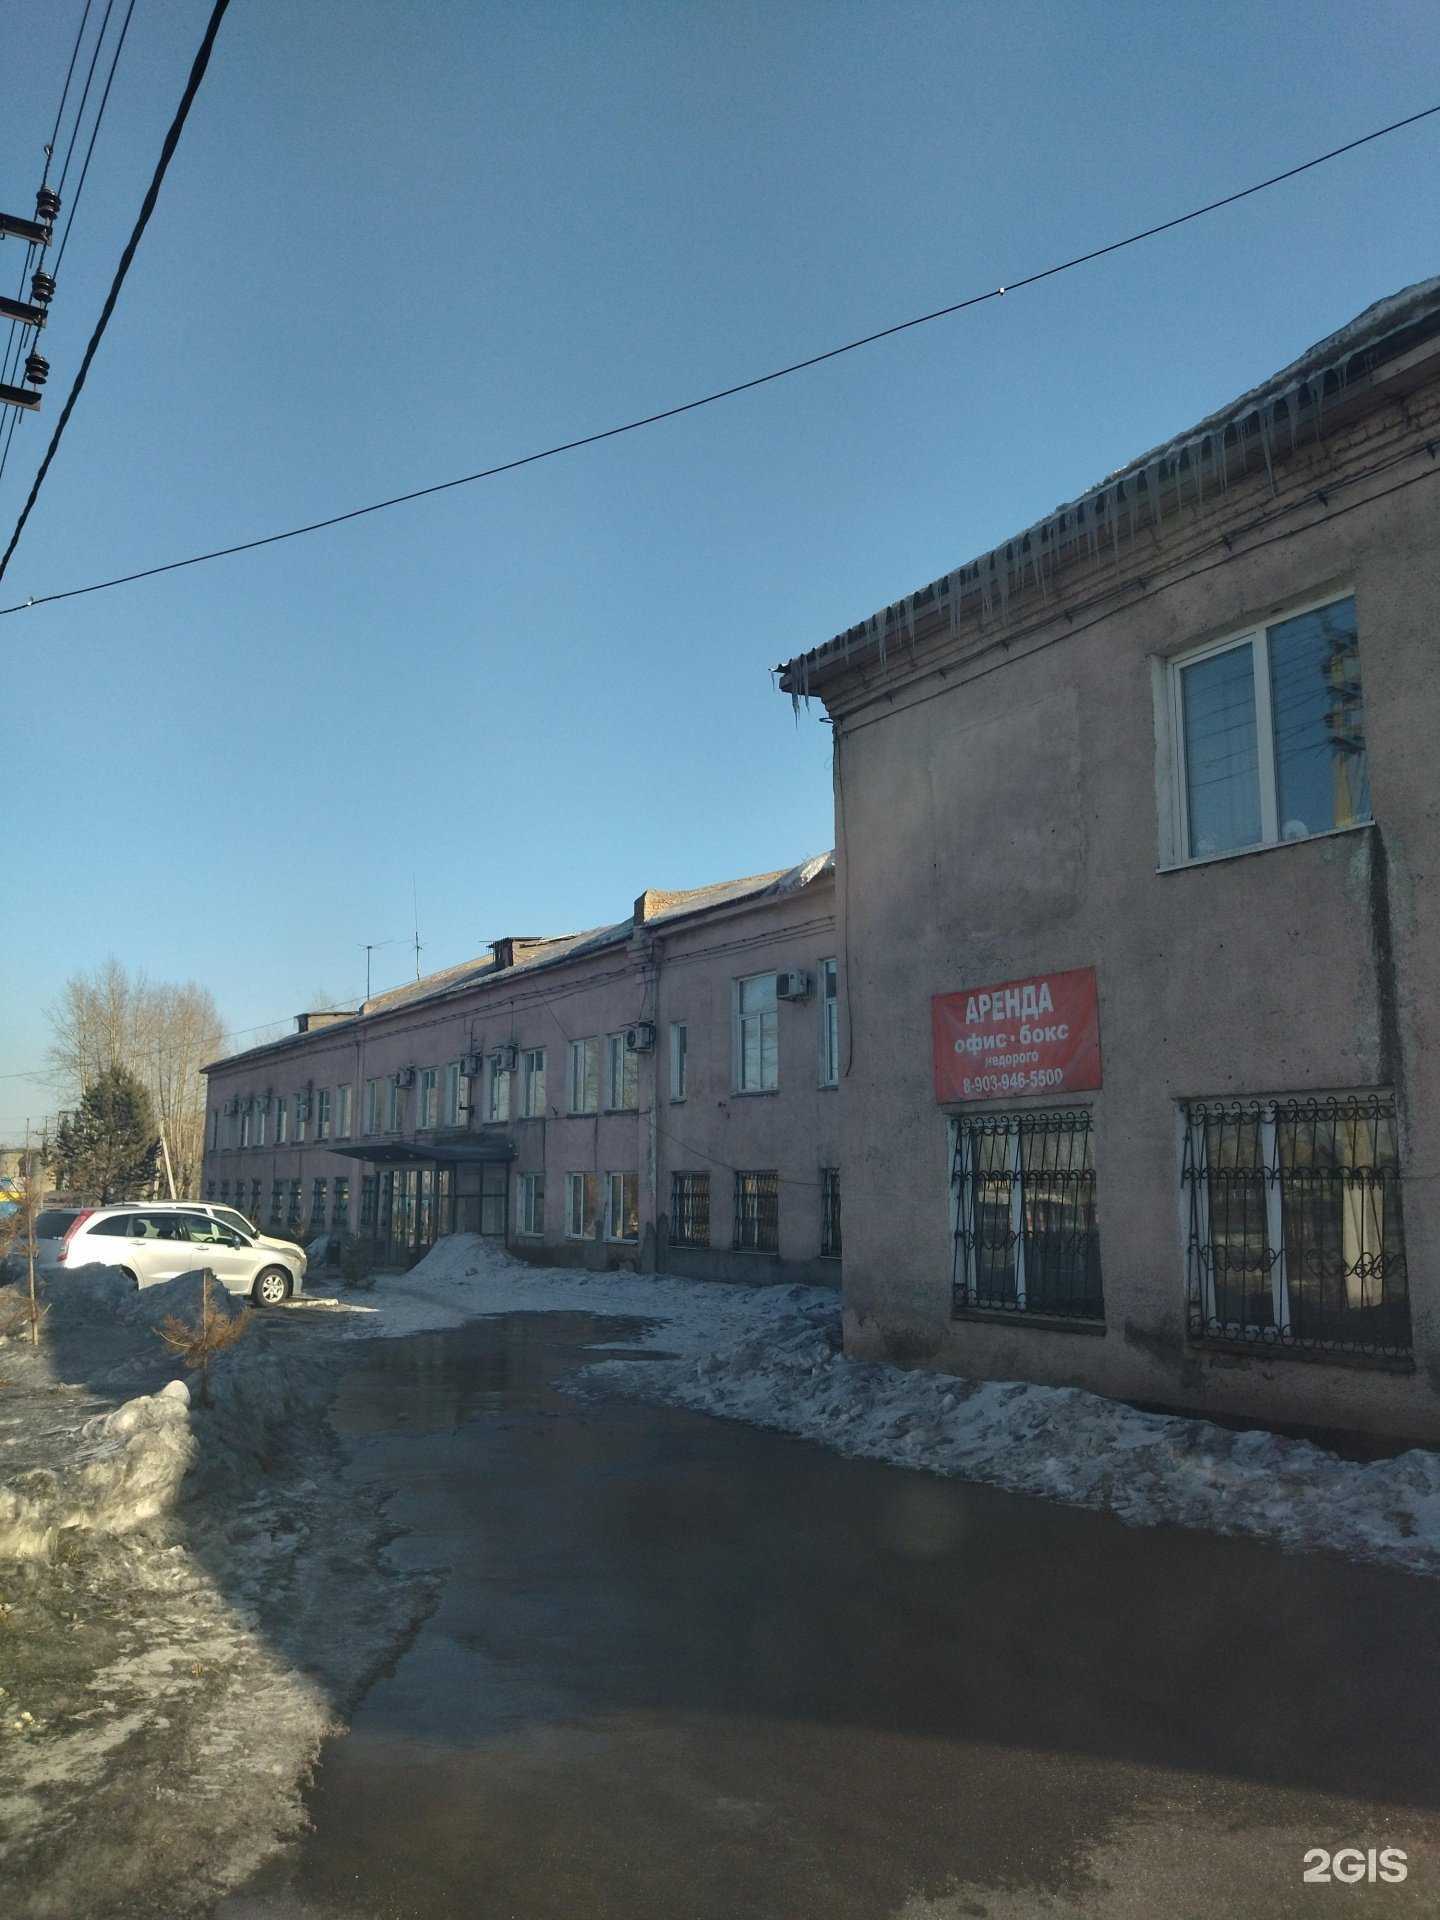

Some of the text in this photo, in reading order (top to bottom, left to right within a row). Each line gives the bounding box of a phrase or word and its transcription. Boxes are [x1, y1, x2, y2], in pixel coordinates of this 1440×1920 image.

[965, 982, 1054, 1024] АРЕНДА
[954, 1024, 1069, 1055] офис бокс
[985, 1051, 1040, 1068] недорого
[963, 1068, 1063, 1094] 8-903-946-5500
